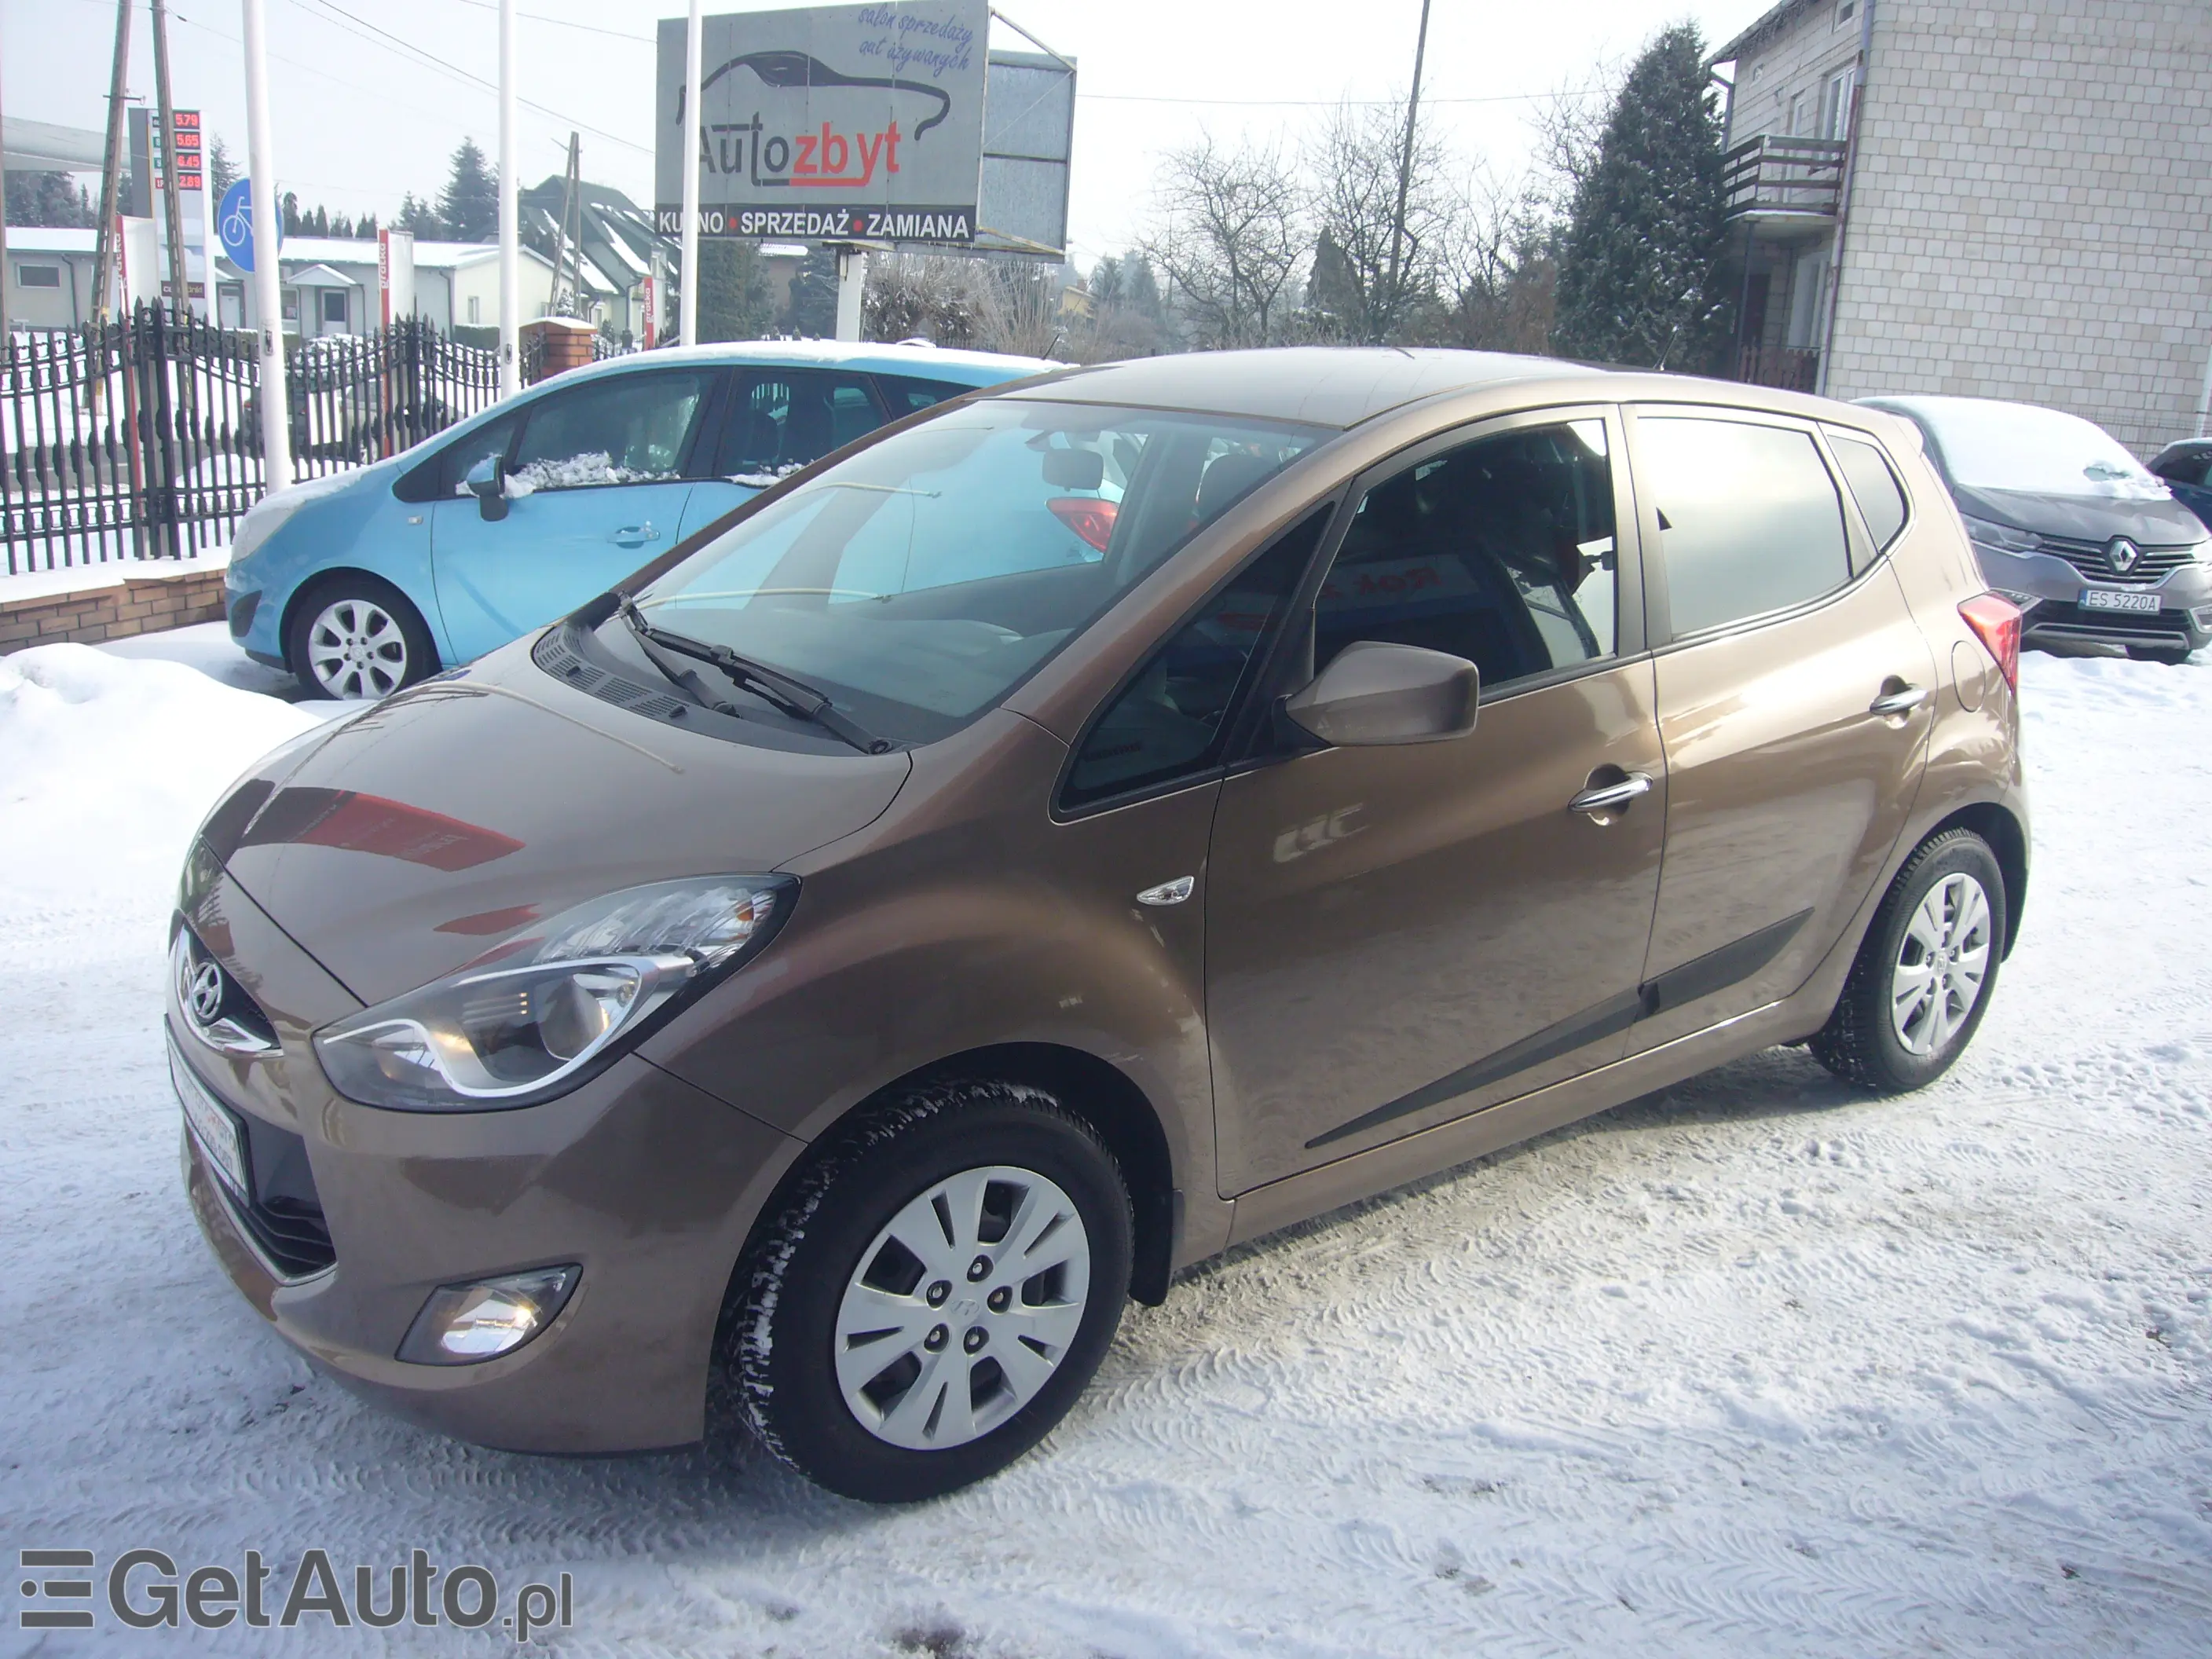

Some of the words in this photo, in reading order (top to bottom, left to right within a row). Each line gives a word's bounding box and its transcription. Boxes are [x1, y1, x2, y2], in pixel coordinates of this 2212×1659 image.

[858, 2, 897, 29] salon
[897, 14, 973, 53] sprzedaży
[887, 42, 972, 78] używanych
[175, 113, 199, 126] 5.79
[178, 174, 202, 188] 2.89
[659, 211, 724, 234] KUNO
[741, 208, 849, 236] SPRZEDAŻ
[866, 214, 969, 238] ZAMIANA
[379, 242, 390, 289] gratka
[645, 287, 654, 324] gratka
[2089, 591, 2109, 606] ES
[2113, 593, 2156, 610] 5220A
